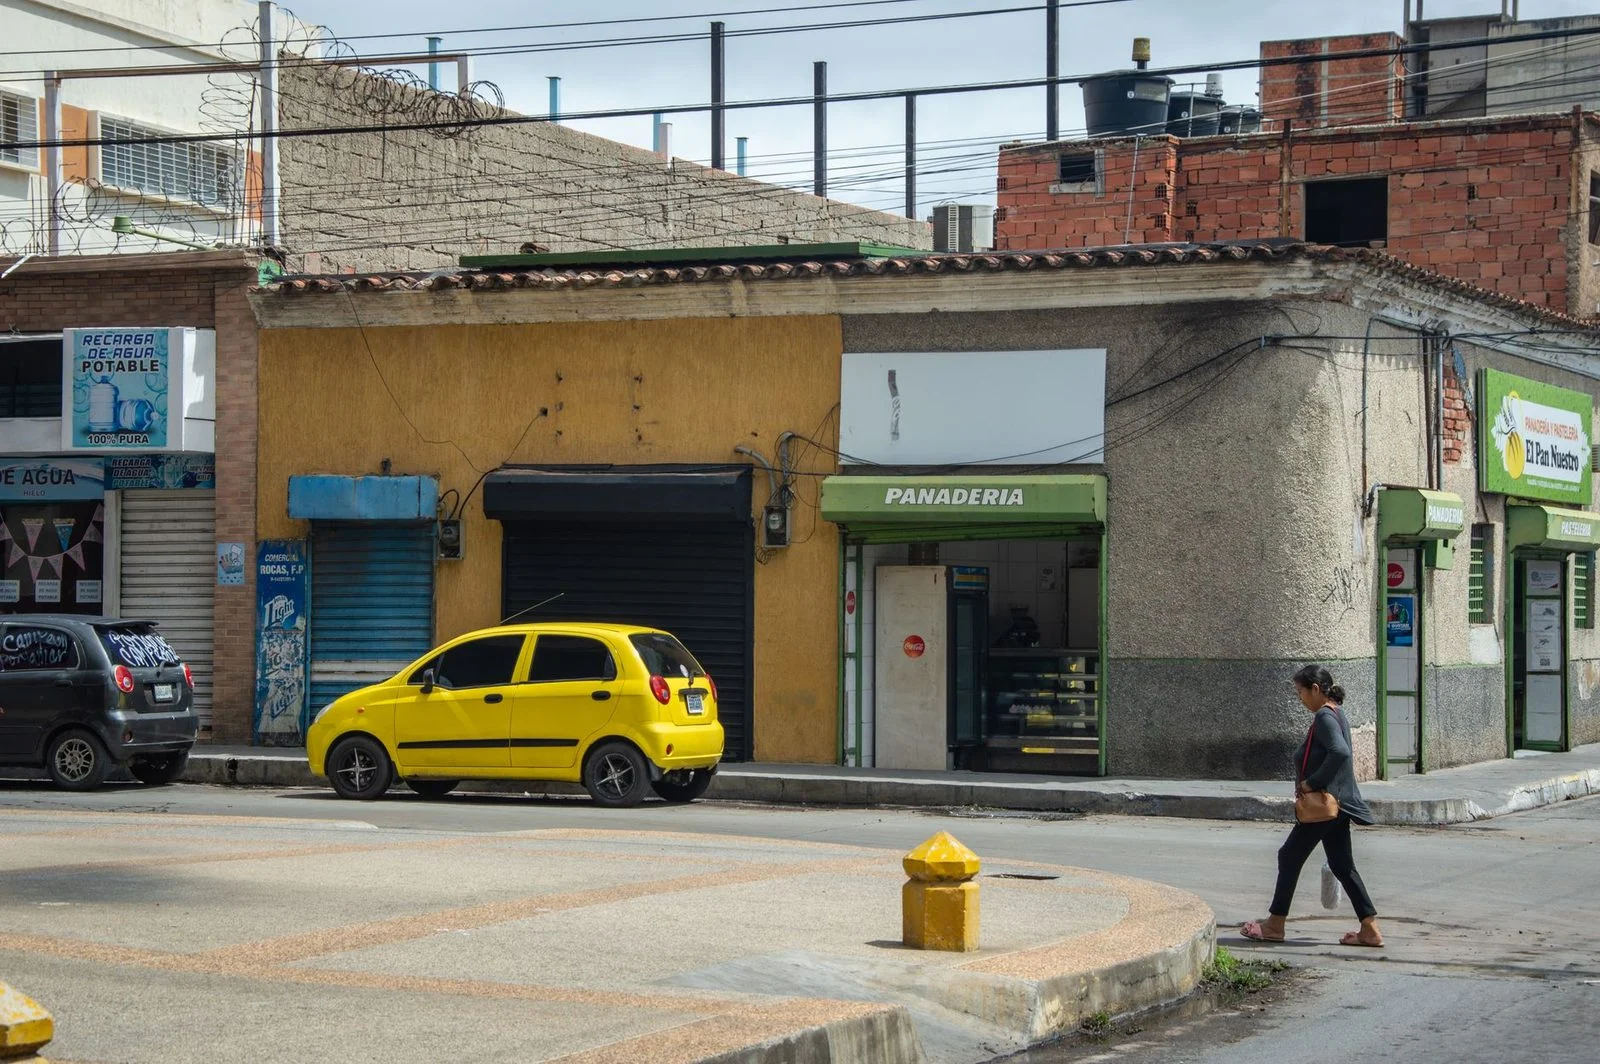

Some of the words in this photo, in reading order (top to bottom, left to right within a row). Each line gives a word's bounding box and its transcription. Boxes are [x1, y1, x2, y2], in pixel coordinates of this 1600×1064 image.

[82, 333, 154, 347] RECARGA
[87, 347, 111, 359] DE
[113, 347, 155, 359] AGUA
[82, 360, 159, 373] POTABLE
[87, 434, 116, 445] 100%
[118, 434, 149, 445] PURA
[1525, 440, 1535, 463] El
[1536, 442, 1550, 467] Pan
[1550, 444, 1579, 472] Nuestro
[112, 458, 151, 467] RECARGA
[0, 469, 15, 485] E
[22, 469, 76, 485] AGUA
[113, 468, 125, 477] DE
[125, 468, 150, 477] AGUA
[112, 479, 151, 488] POTABLE
[23, 489, 46, 497] HIELO
[884, 487, 1024, 506] PANADERIA
[1428, 505, 1463, 524] PANADERIA
[260, 564, 289, 576] ROCAS,
